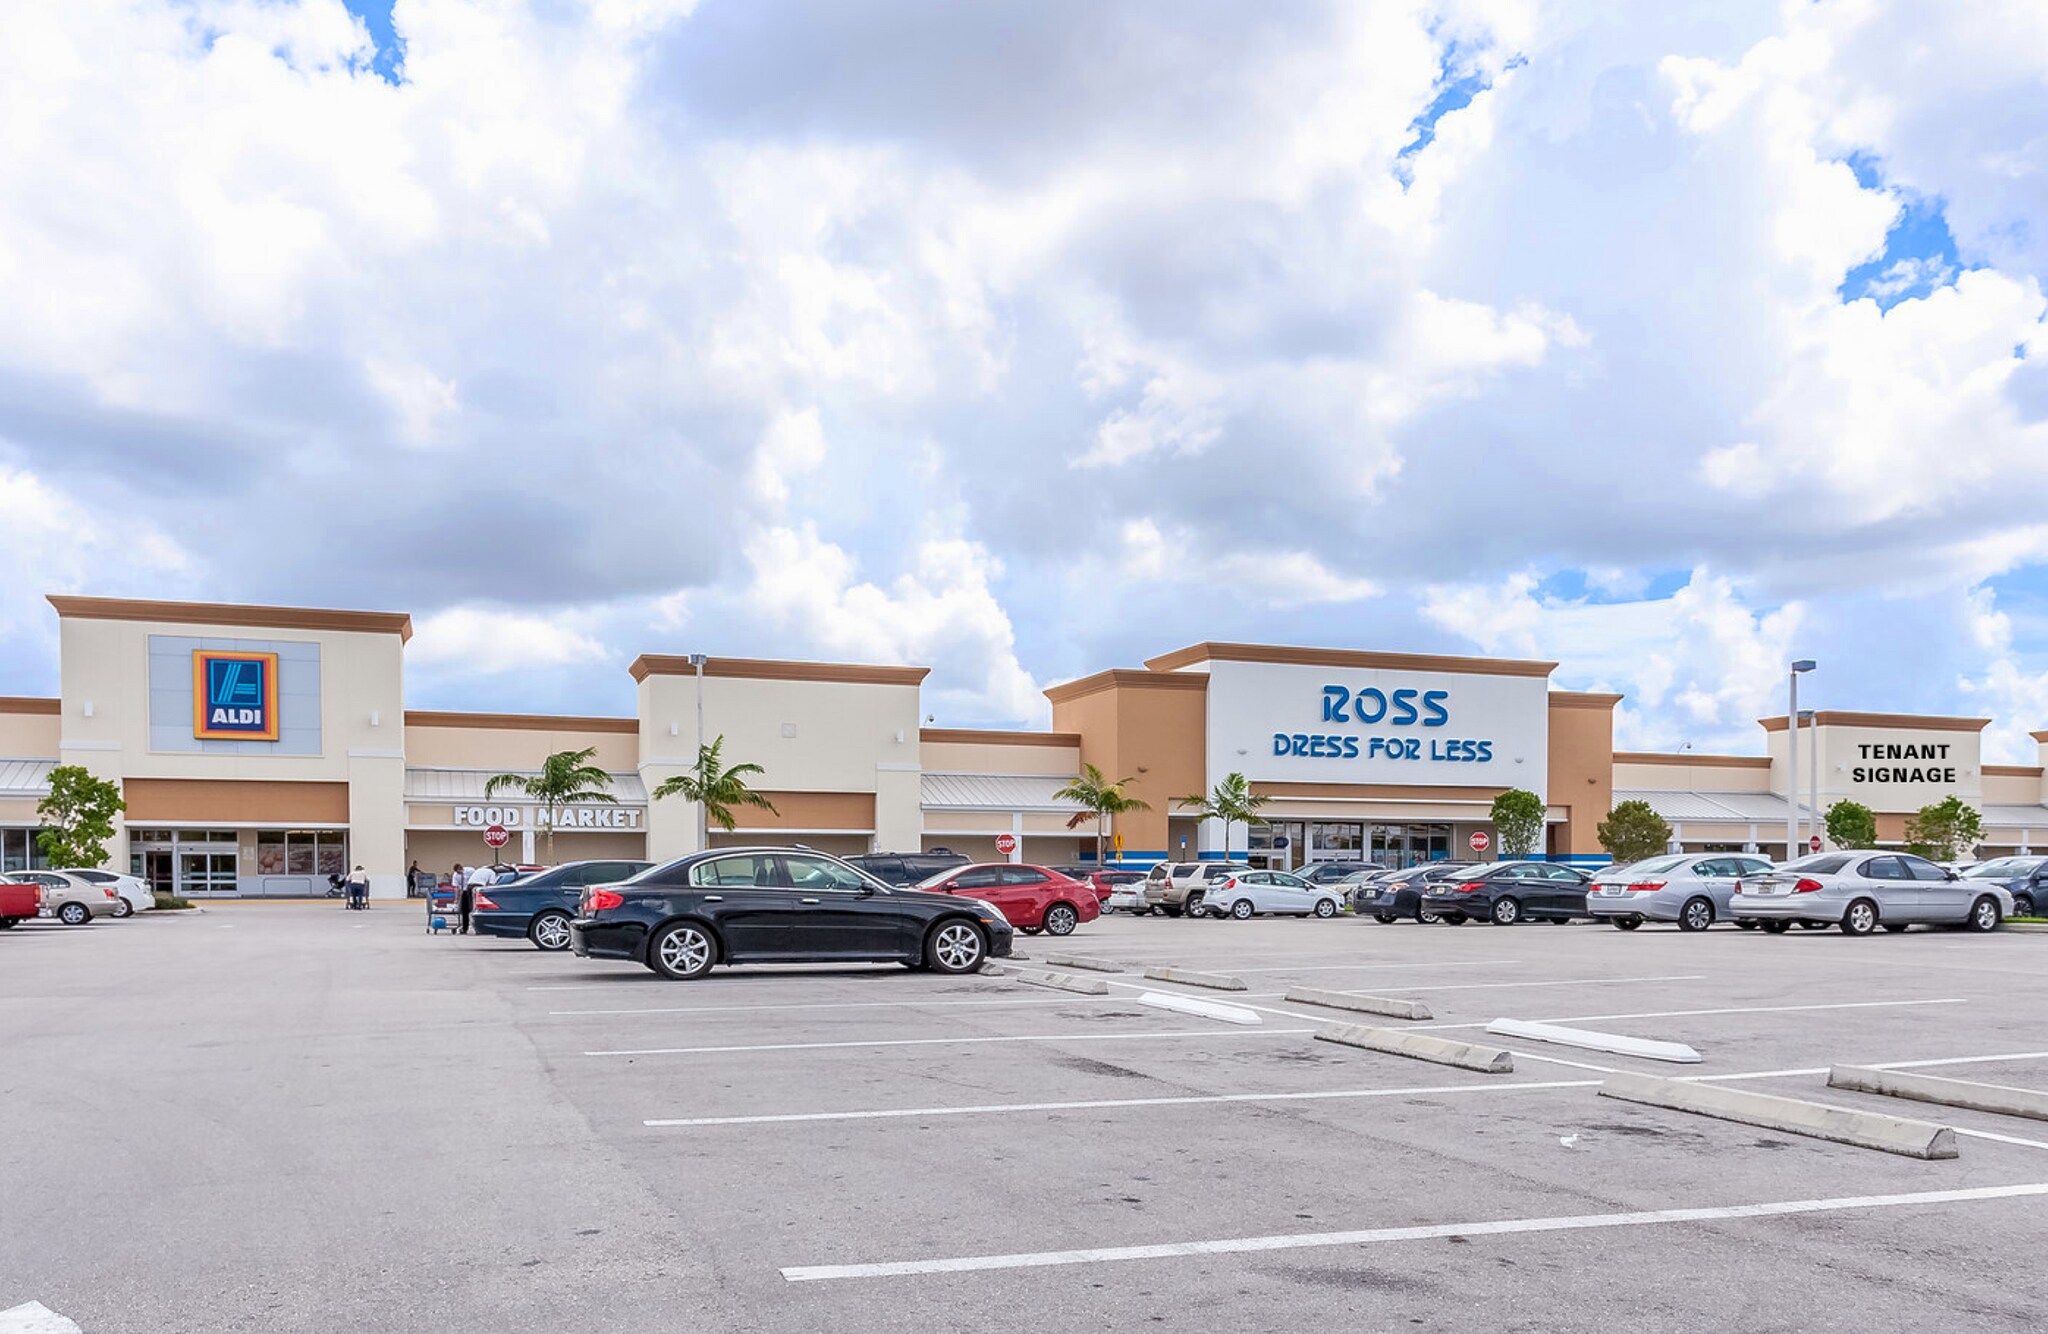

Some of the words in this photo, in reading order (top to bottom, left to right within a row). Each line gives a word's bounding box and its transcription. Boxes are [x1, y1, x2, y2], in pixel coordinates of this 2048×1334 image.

[1323, 684, 1448, 726] ROSS
[211, 708, 262, 724] ALDI
[1274, 733, 1359, 758] DRESS
[1369, 737, 1420, 760] FOR
[1431, 739, 1493, 762] LESS
[1858, 744, 1950, 760] TENANT
[1852, 767, 1956, 783] SIGNAGE
[454, 806, 520, 826] FOOD
[537, 807, 640, 827] MARKET
[484, 831, 507, 841] STOP
[996, 839, 1015, 848] STOP
[1470, 837, 1488, 846] STOP
